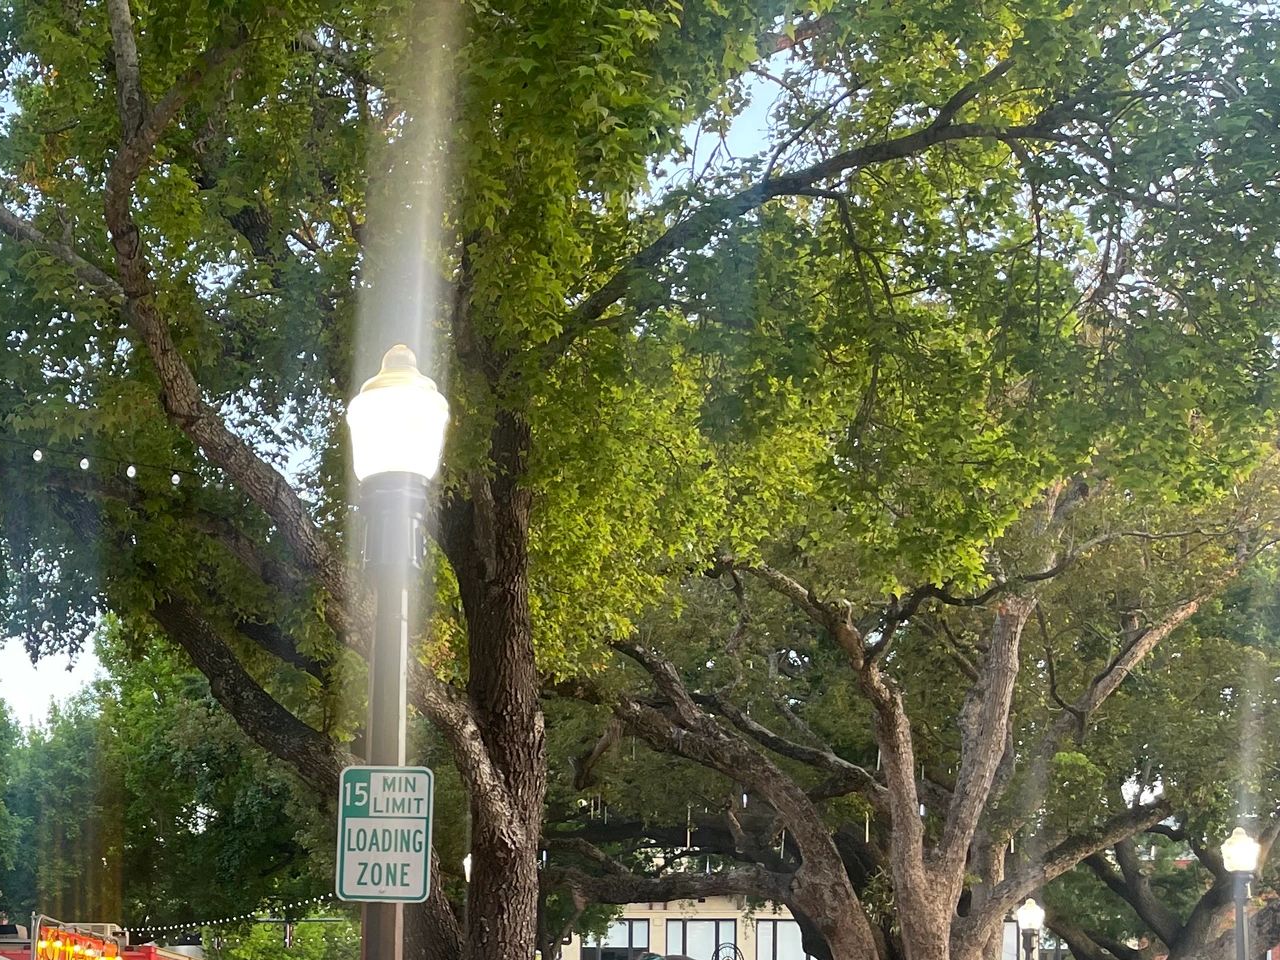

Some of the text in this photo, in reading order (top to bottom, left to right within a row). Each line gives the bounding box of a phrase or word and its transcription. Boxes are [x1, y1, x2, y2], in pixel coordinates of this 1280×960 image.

[345, 782, 368, 806] 15
[382, 776, 416, 793] MIN
[373, 798, 424, 814] LIMIT
[347, 828, 423, 853] LOADING
[356, 862, 411, 887] ZONE
